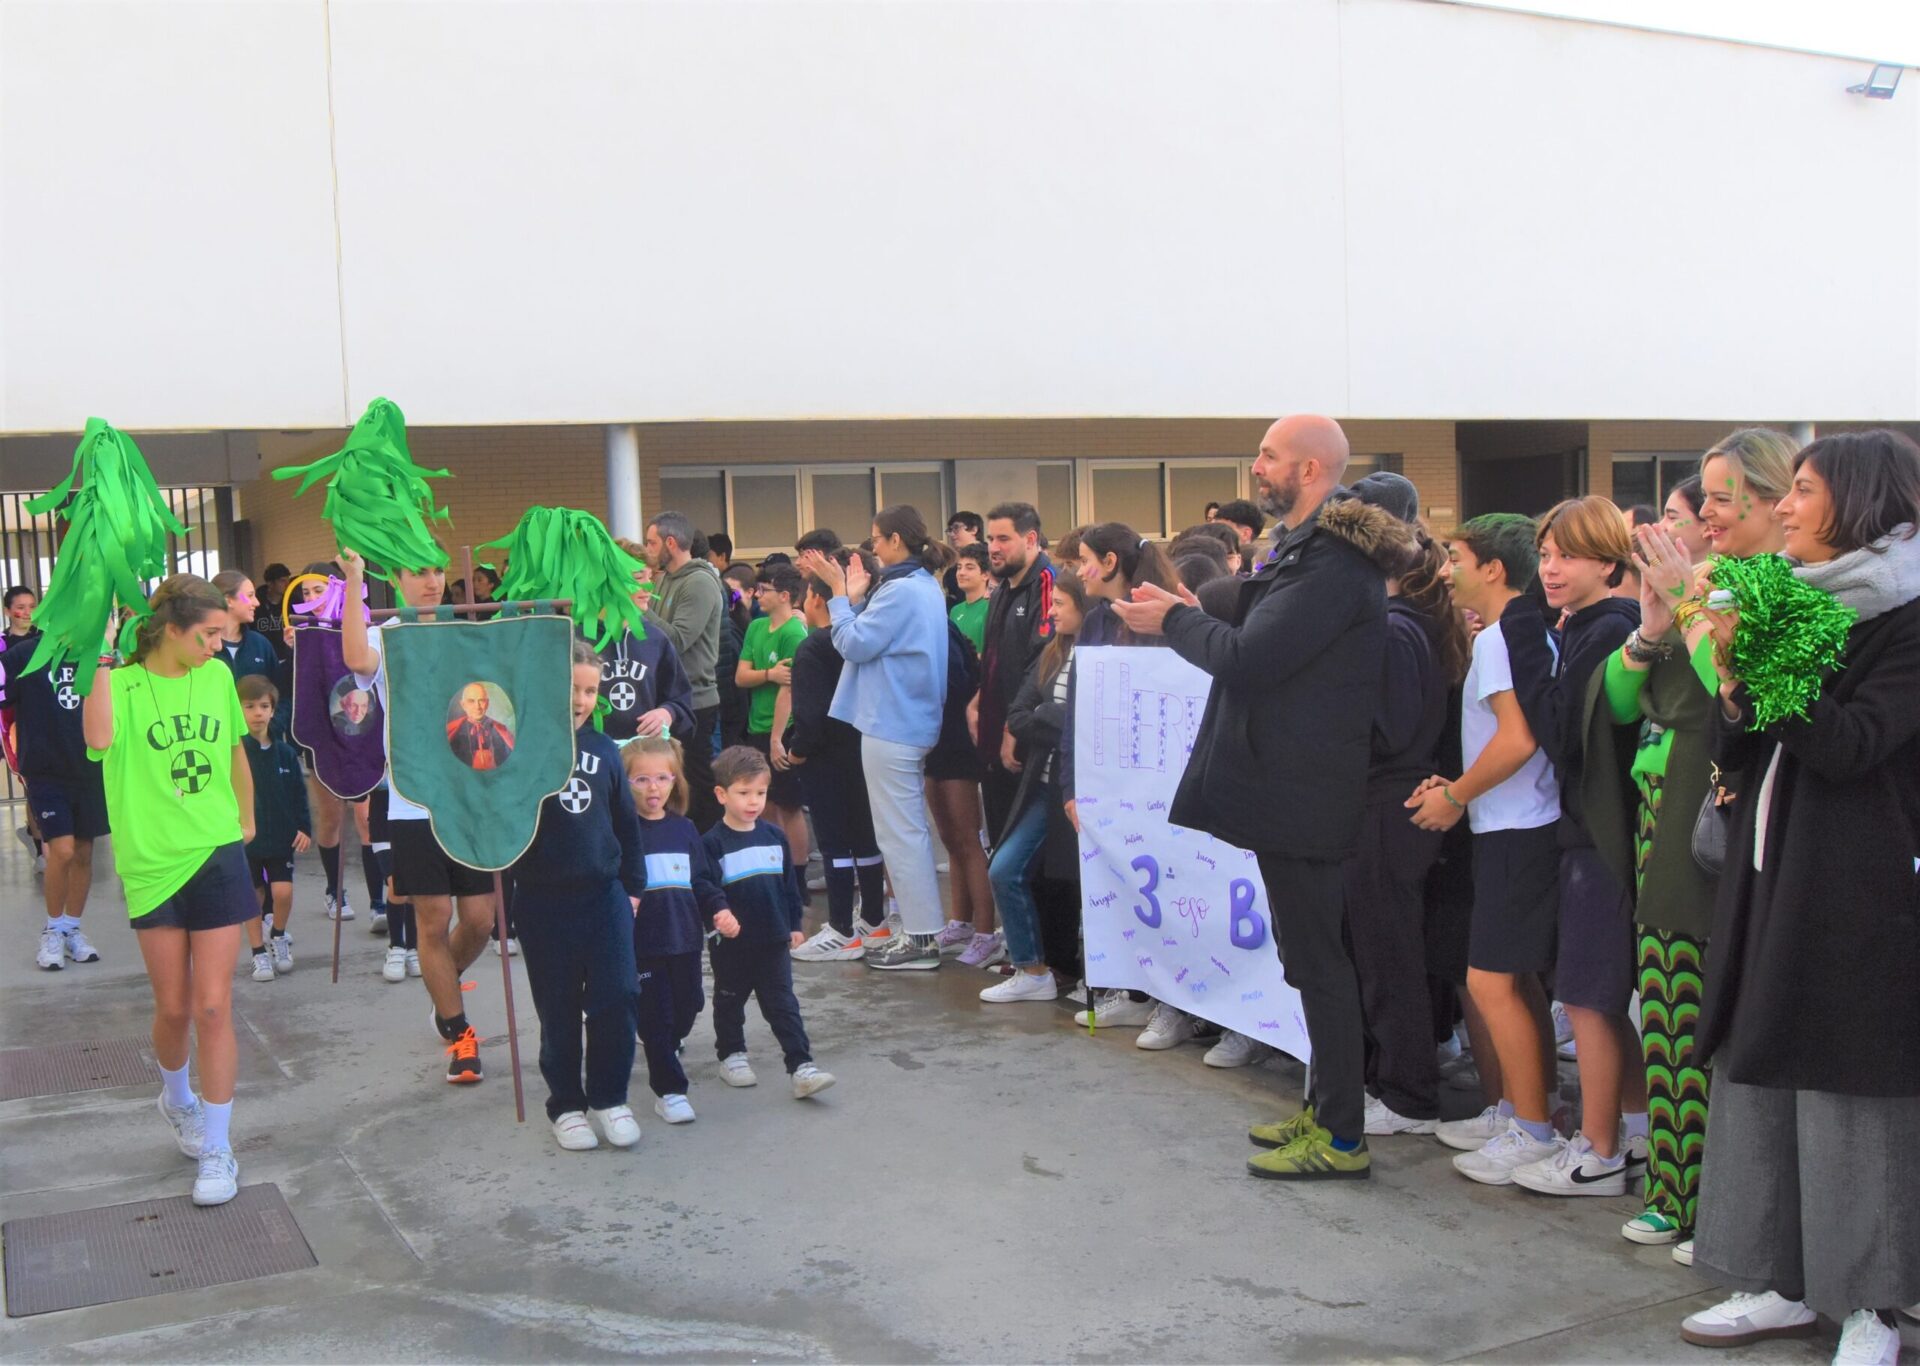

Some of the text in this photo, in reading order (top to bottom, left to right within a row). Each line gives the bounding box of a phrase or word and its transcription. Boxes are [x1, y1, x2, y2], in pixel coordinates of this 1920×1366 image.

[48, 667, 75, 684] CE
[601, 659, 648, 681] CEU
[147, 714, 221, 751] CEU
[1229, 877, 1266, 950] B
